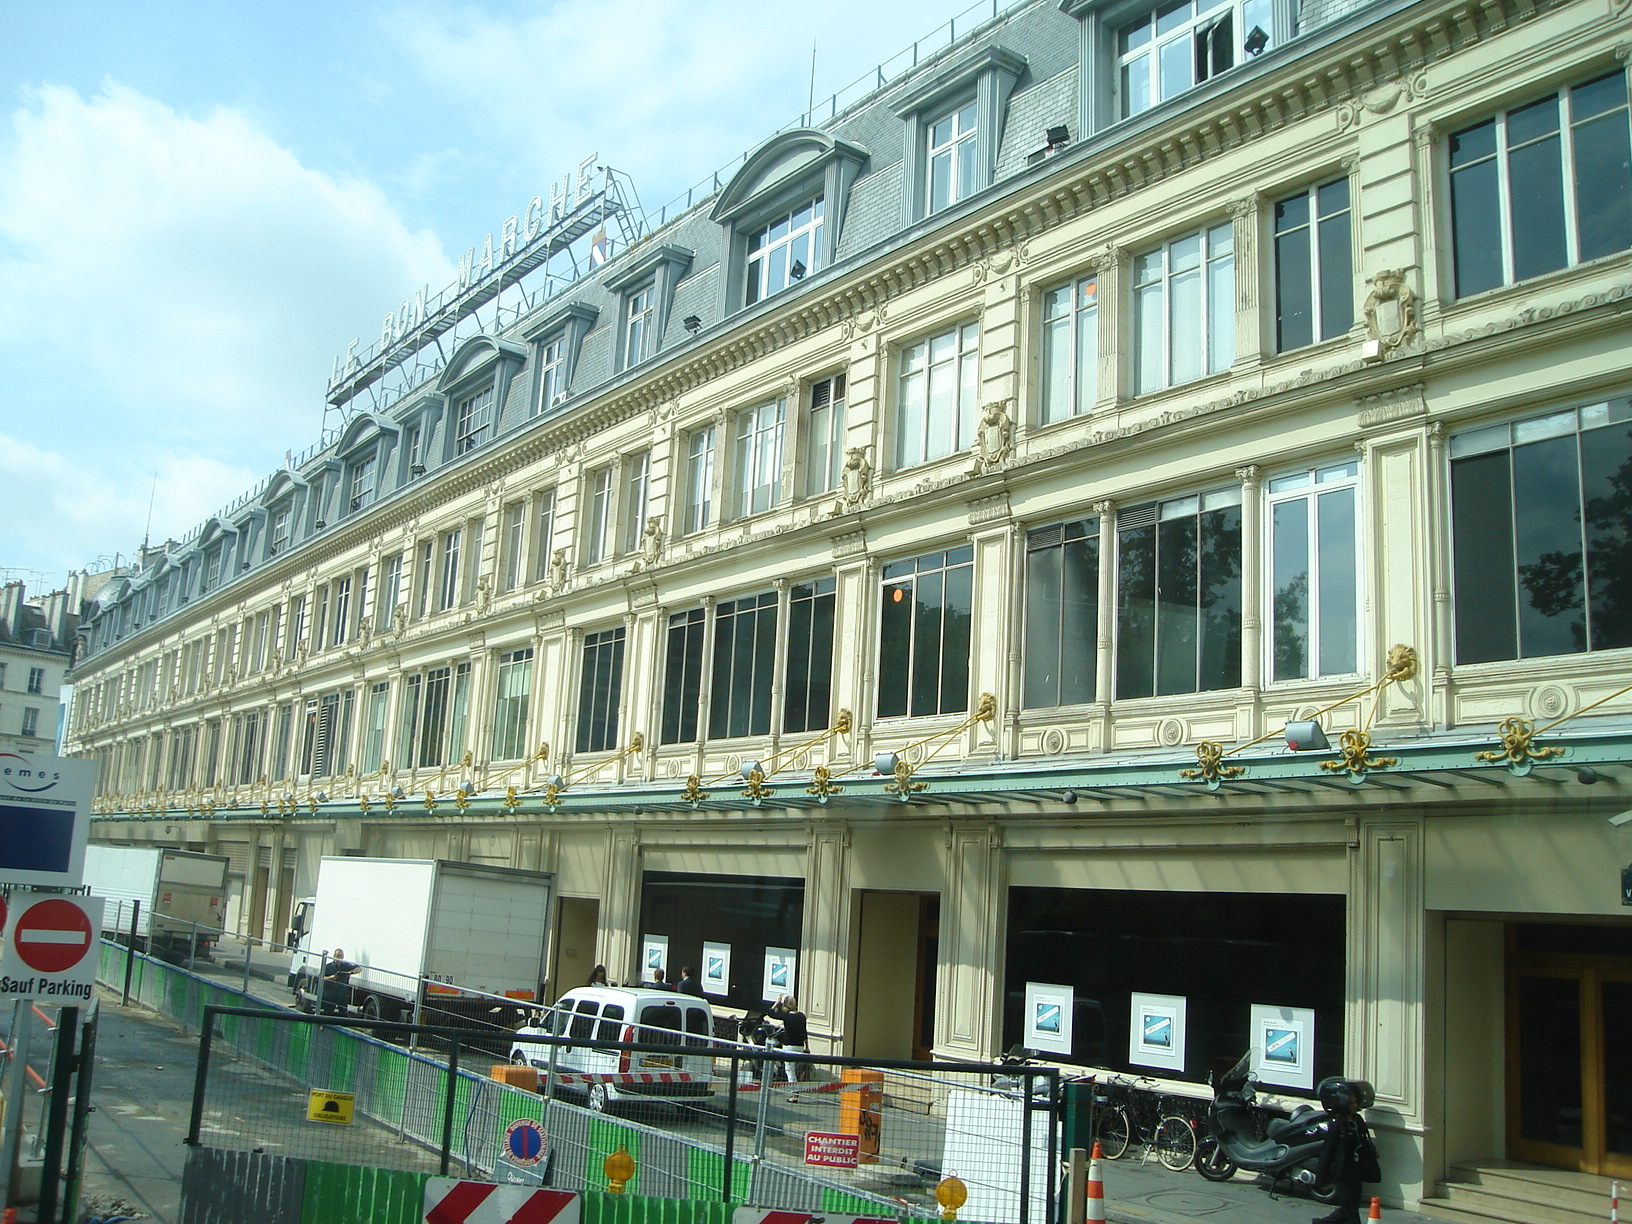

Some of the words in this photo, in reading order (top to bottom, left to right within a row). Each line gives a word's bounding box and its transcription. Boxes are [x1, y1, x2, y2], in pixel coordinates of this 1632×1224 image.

[330, 337, 359, 390] LE
[380, 283, 429, 353] BON
[456, 151, 598, 297] MARCHE
[1, 976, 35, 994] Sauf
[38, 978, 92, 1000] Parking
[808, 1136, 858, 1147] CHANTIER
[811, 1146, 855, 1155] INTERDIT
[823, 1155, 857, 1164] PUBLIC
